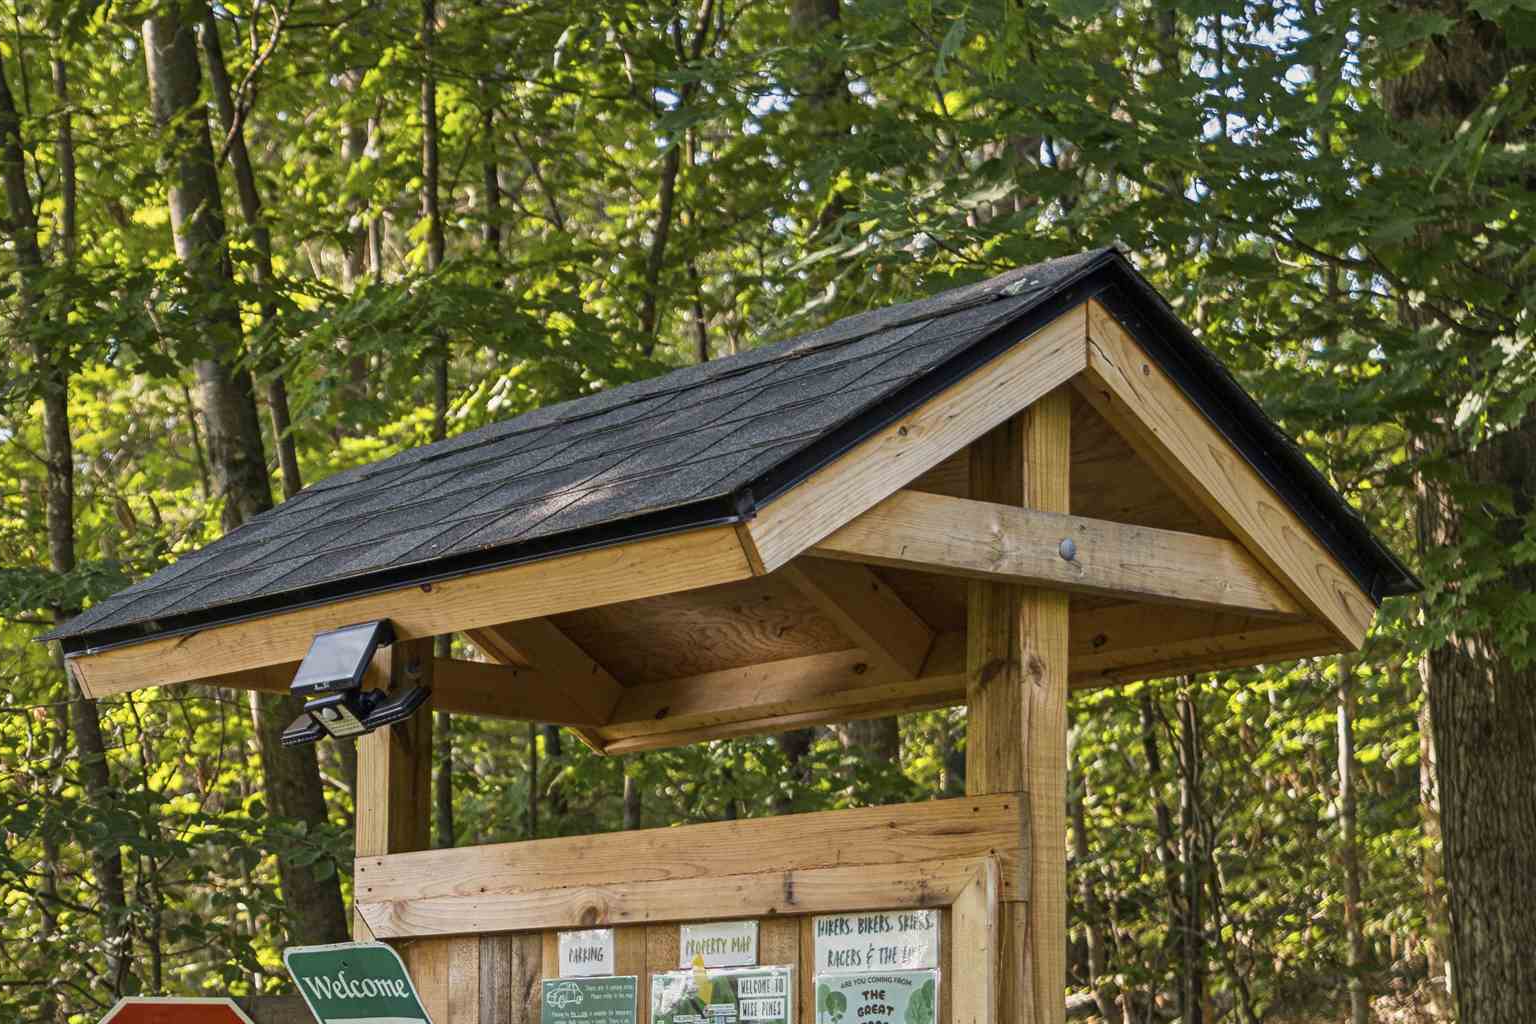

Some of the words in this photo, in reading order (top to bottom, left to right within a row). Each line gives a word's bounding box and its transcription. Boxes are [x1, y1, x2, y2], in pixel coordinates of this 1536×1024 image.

[686, 937, 727, 955] PROPERTY
[731, 935, 752, 953] MAP
[569, 946, 604, 963] PARKING
[827, 948, 861, 967] RACERS
[879, 946, 897, 964] THE
[302, 970, 410, 1000] Welcome
[740, 977, 771, 994] WELCOME
[774, 977, 784, 994] TO
[841, 980, 853, 988] ARE
[854, 977, 866, 985] YOU
[867, 976, 892, 984] COMING
[893, 976, 913, 987] FROM
[862, 989, 886, 1000] THE
[741, 1000, 759, 1016] WISE
[760, 999, 782, 1016] PINES
[857, 1004, 894, 1017] GREAT
